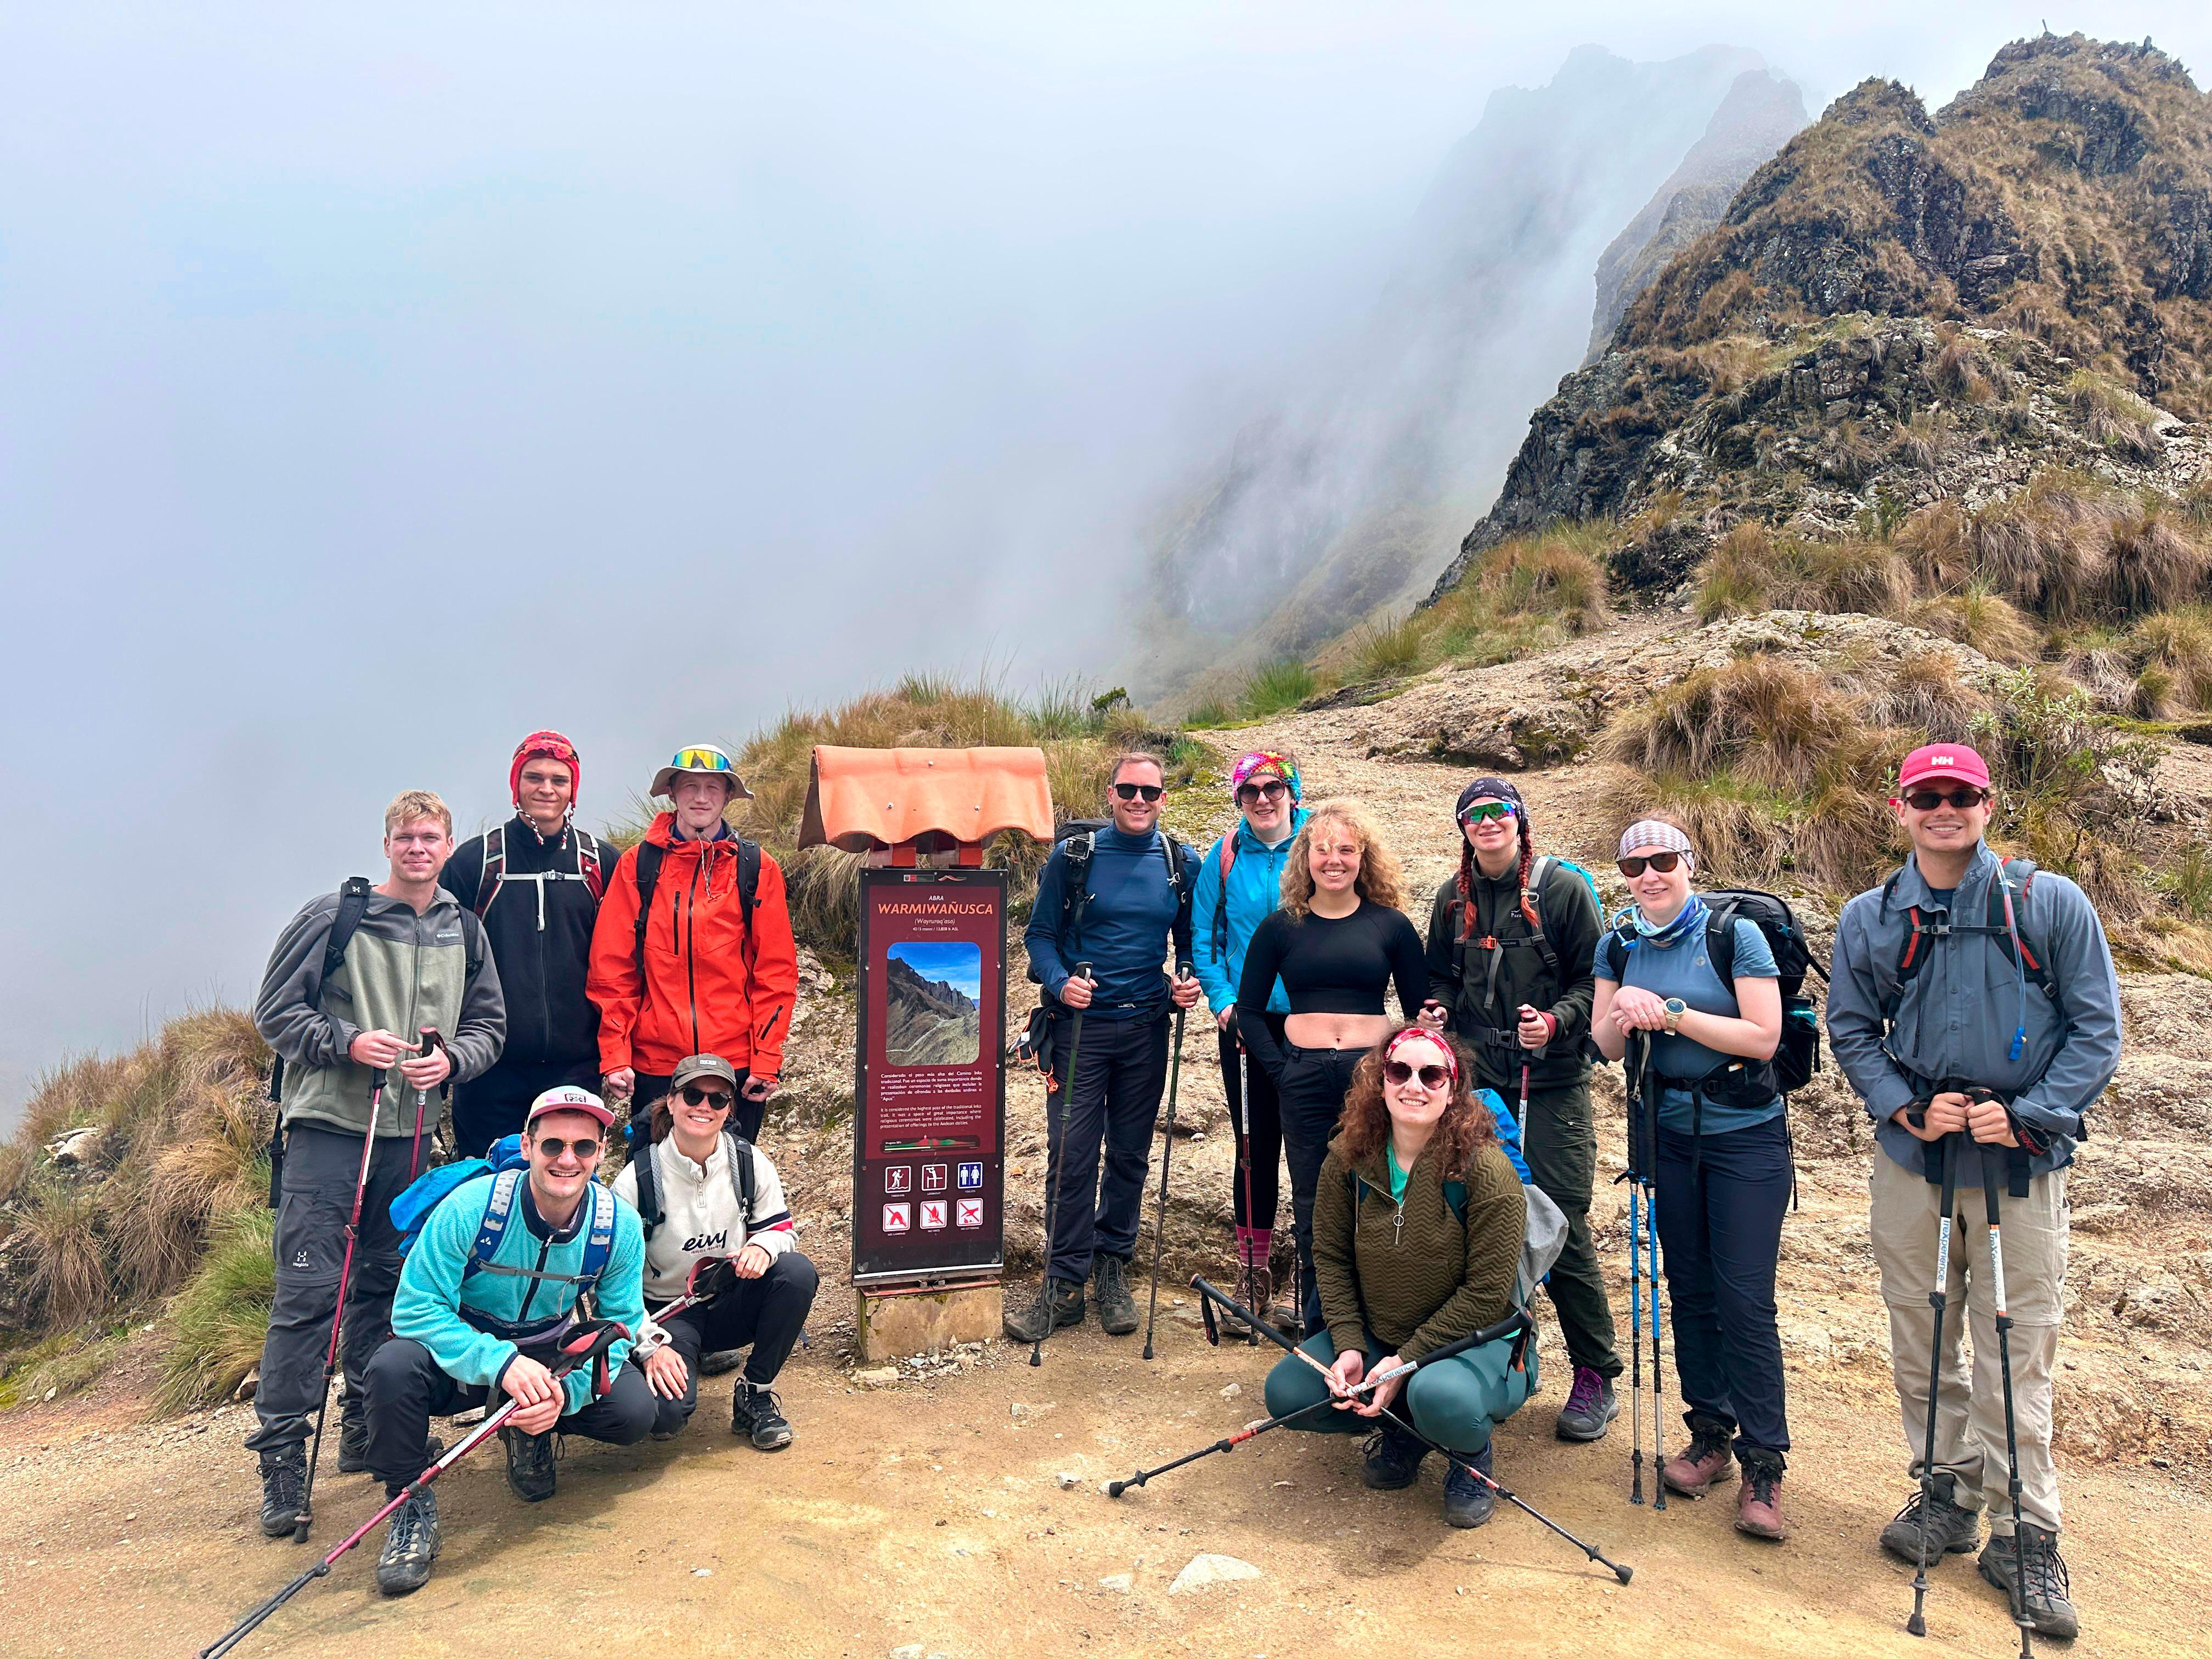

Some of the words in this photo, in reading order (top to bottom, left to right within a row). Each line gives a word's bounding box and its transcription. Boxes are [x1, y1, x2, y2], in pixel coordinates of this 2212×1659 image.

[1931, 757, 1953, 765] HH
[878, 901, 993, 914] WARMIWAÑUSCA
[682, 1229, 727, 1251] eivy
